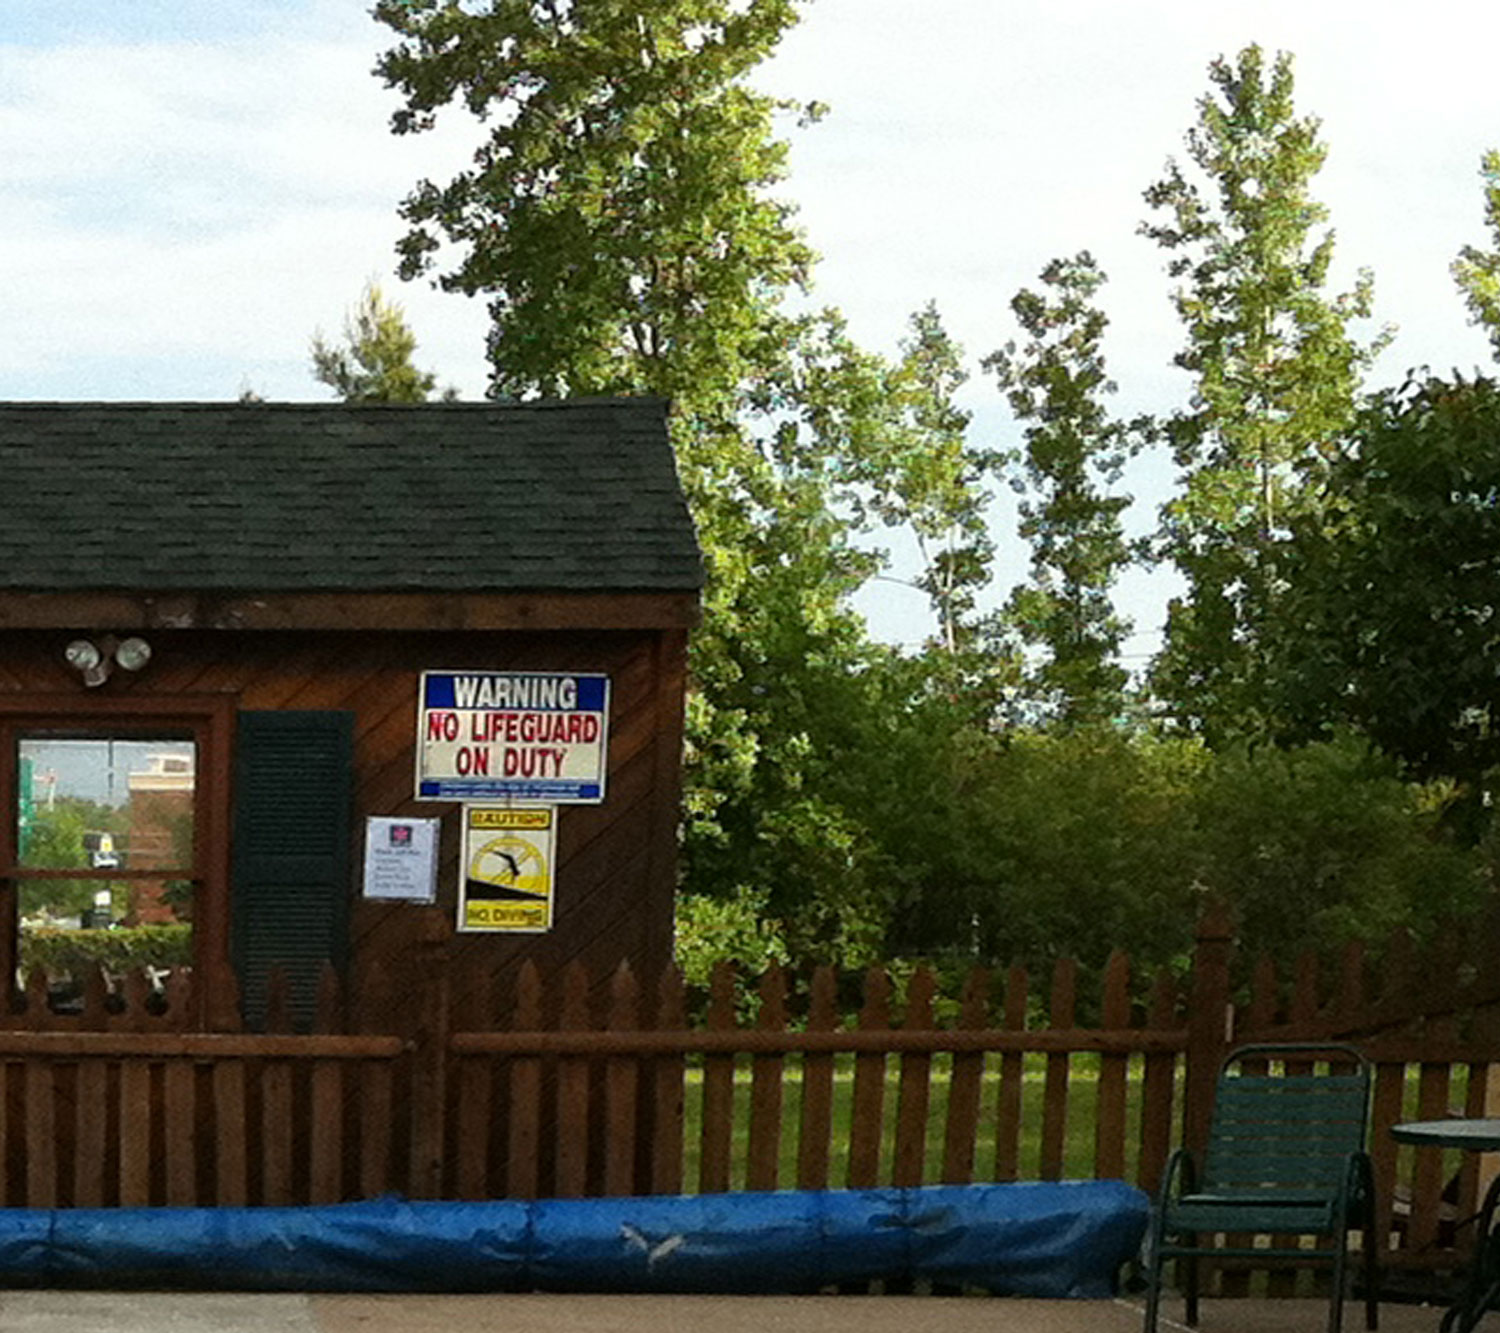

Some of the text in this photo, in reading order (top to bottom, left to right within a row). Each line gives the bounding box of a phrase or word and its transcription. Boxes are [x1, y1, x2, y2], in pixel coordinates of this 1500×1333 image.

[453, 676, 578, 709] WARNING
[427, 711, 599, 744] NO LIFEGUARD
[456, 747, 567, 777] ON DUTY
